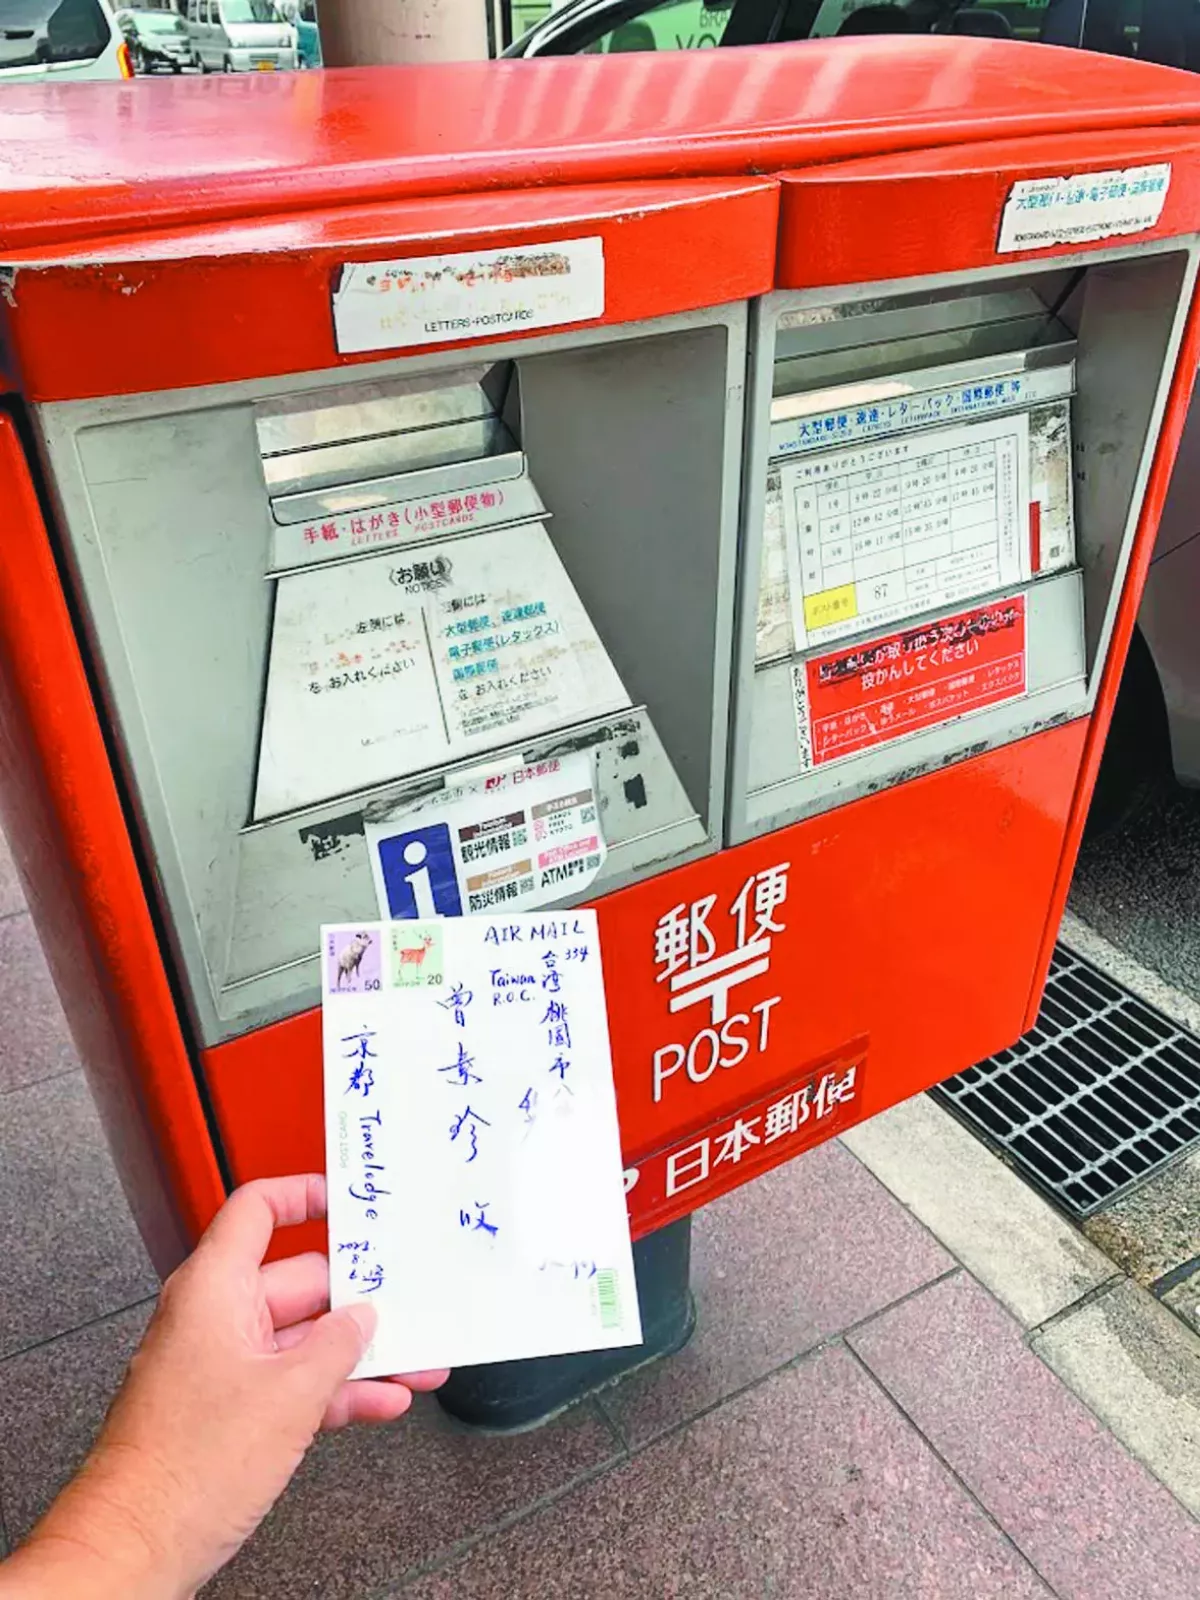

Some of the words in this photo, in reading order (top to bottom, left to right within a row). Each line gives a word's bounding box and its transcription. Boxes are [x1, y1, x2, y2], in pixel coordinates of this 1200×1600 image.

[874, 583, 888, 600] 87
[861, 638, 980, 691] 投かんしてください
[512, 758, 561, 785] 日本郵便
[460, 832, 511, 864] 観光情報
[468, 880, 518, 913] 防災情報
[484, 925, 523, 946] AIR
[530, 920, 585, 941] MAIL
[655, 861, 791, 984] 郵便
[365, 978, 381, 992] 50
[427, 973, 443, 986] 20
[489, 968, 537, 988] Taiwan
[653, 996, 782, 1104] POST
[665, 1065, 858, 1199] 日本郵便
